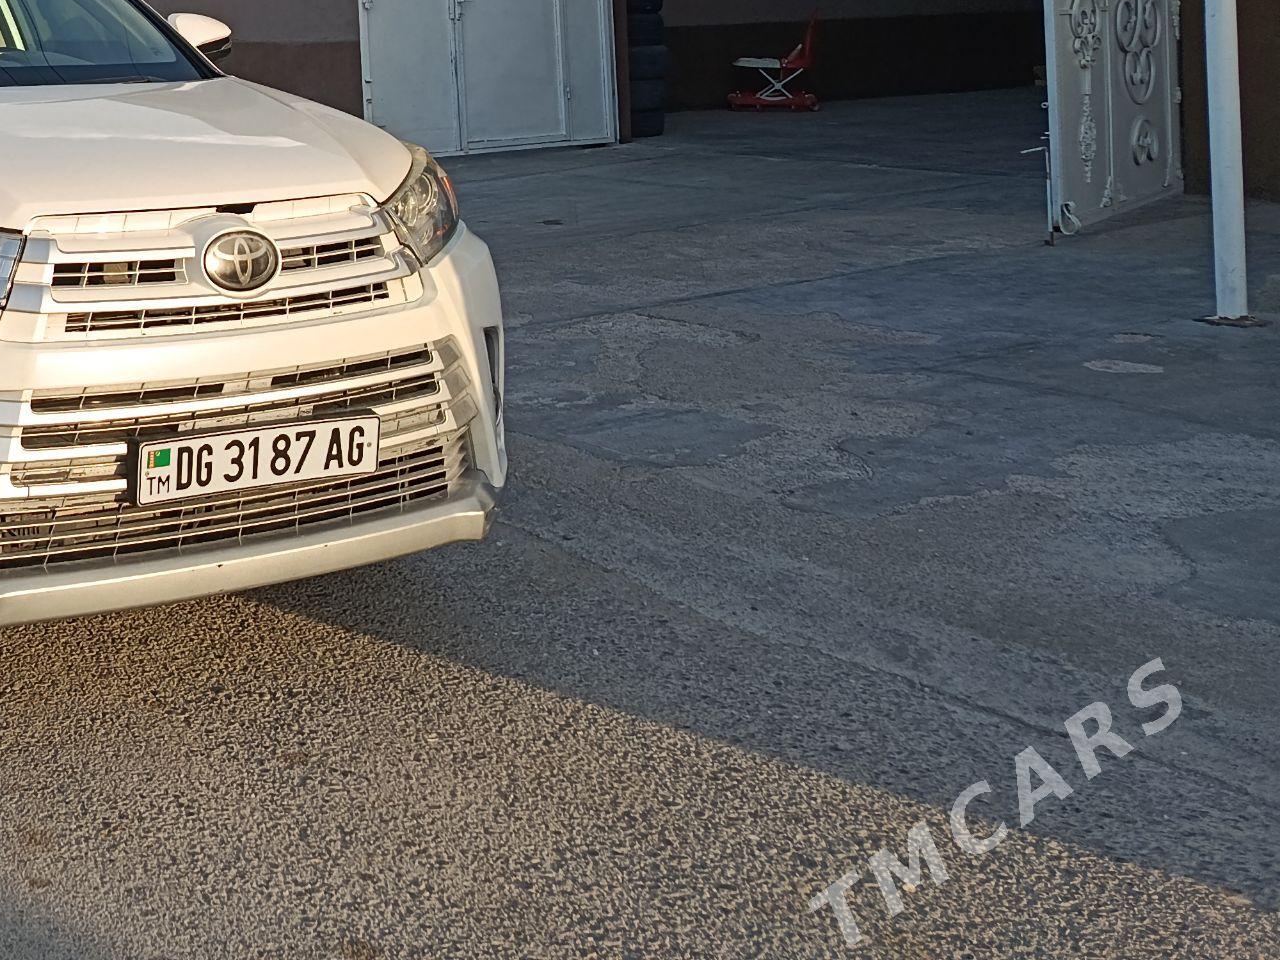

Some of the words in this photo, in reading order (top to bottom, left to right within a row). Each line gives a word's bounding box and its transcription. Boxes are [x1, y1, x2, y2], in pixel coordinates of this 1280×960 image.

[176, 443, 213, 491] DG
[323, 425, 365, 470] AG
[146, 475, 170, 496] TM
